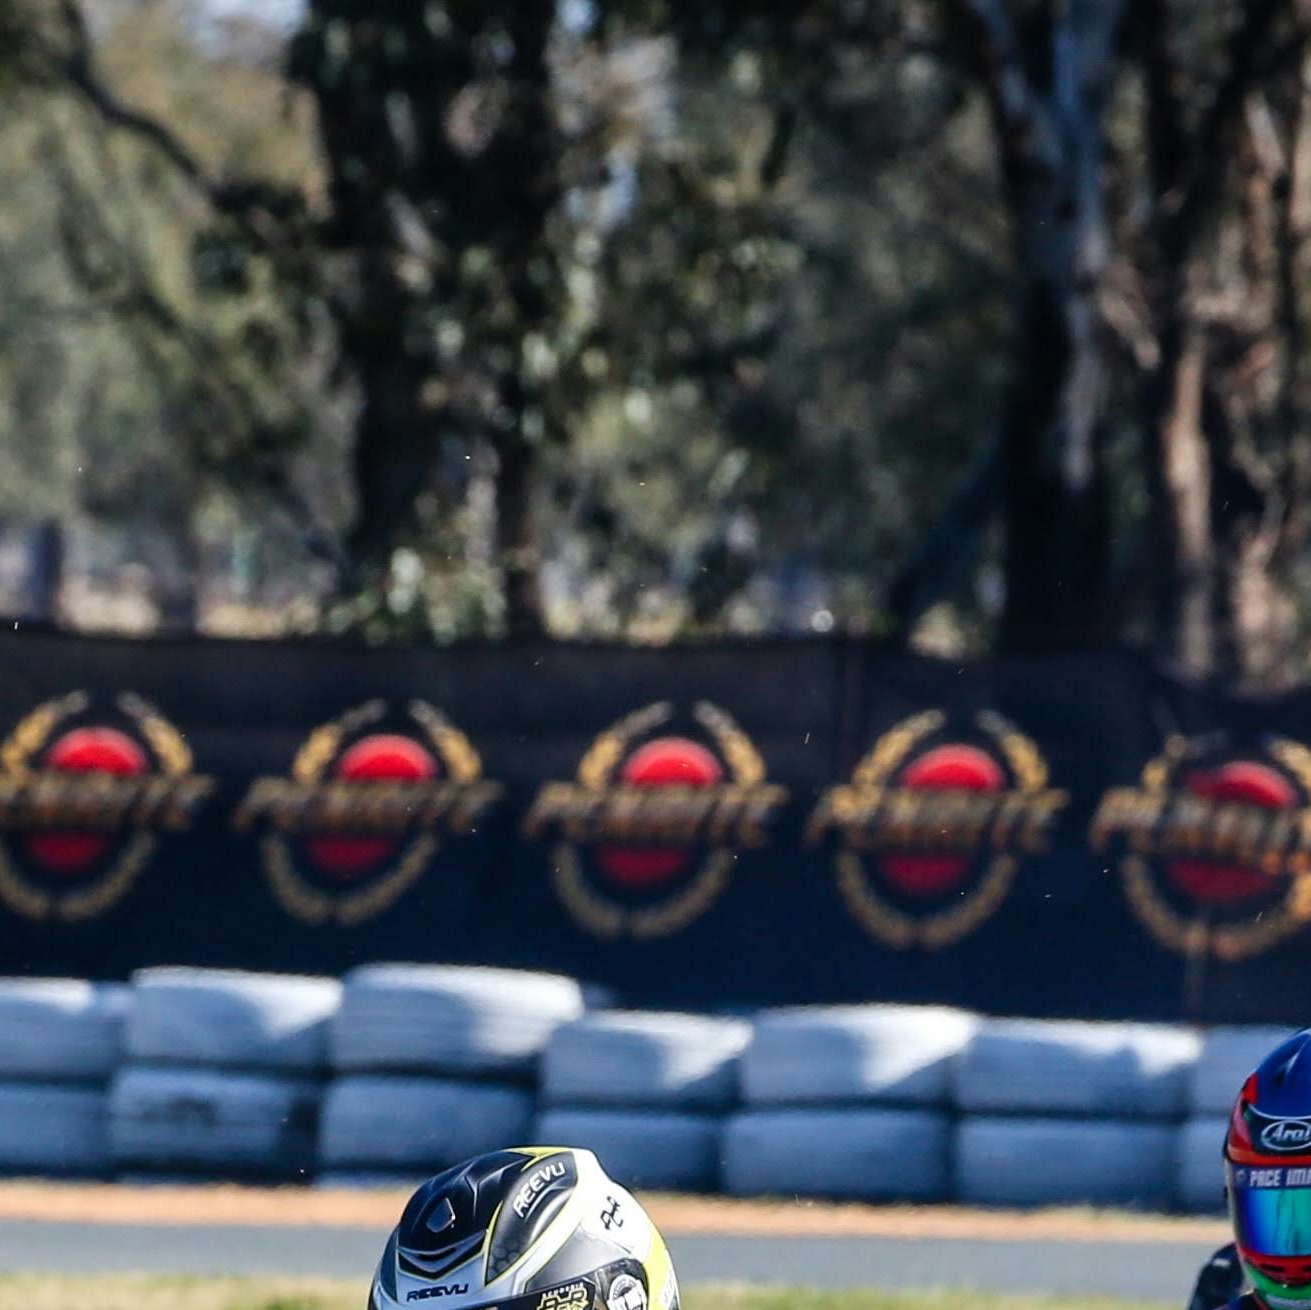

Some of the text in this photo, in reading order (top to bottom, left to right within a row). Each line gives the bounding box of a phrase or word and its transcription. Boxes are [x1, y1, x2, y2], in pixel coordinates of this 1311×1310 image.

[1271, 1120, 1311, 1141] Arai
[513, 1162, 565, 1217] REEVU
[406, 1284, 469, 1301] REEVU
